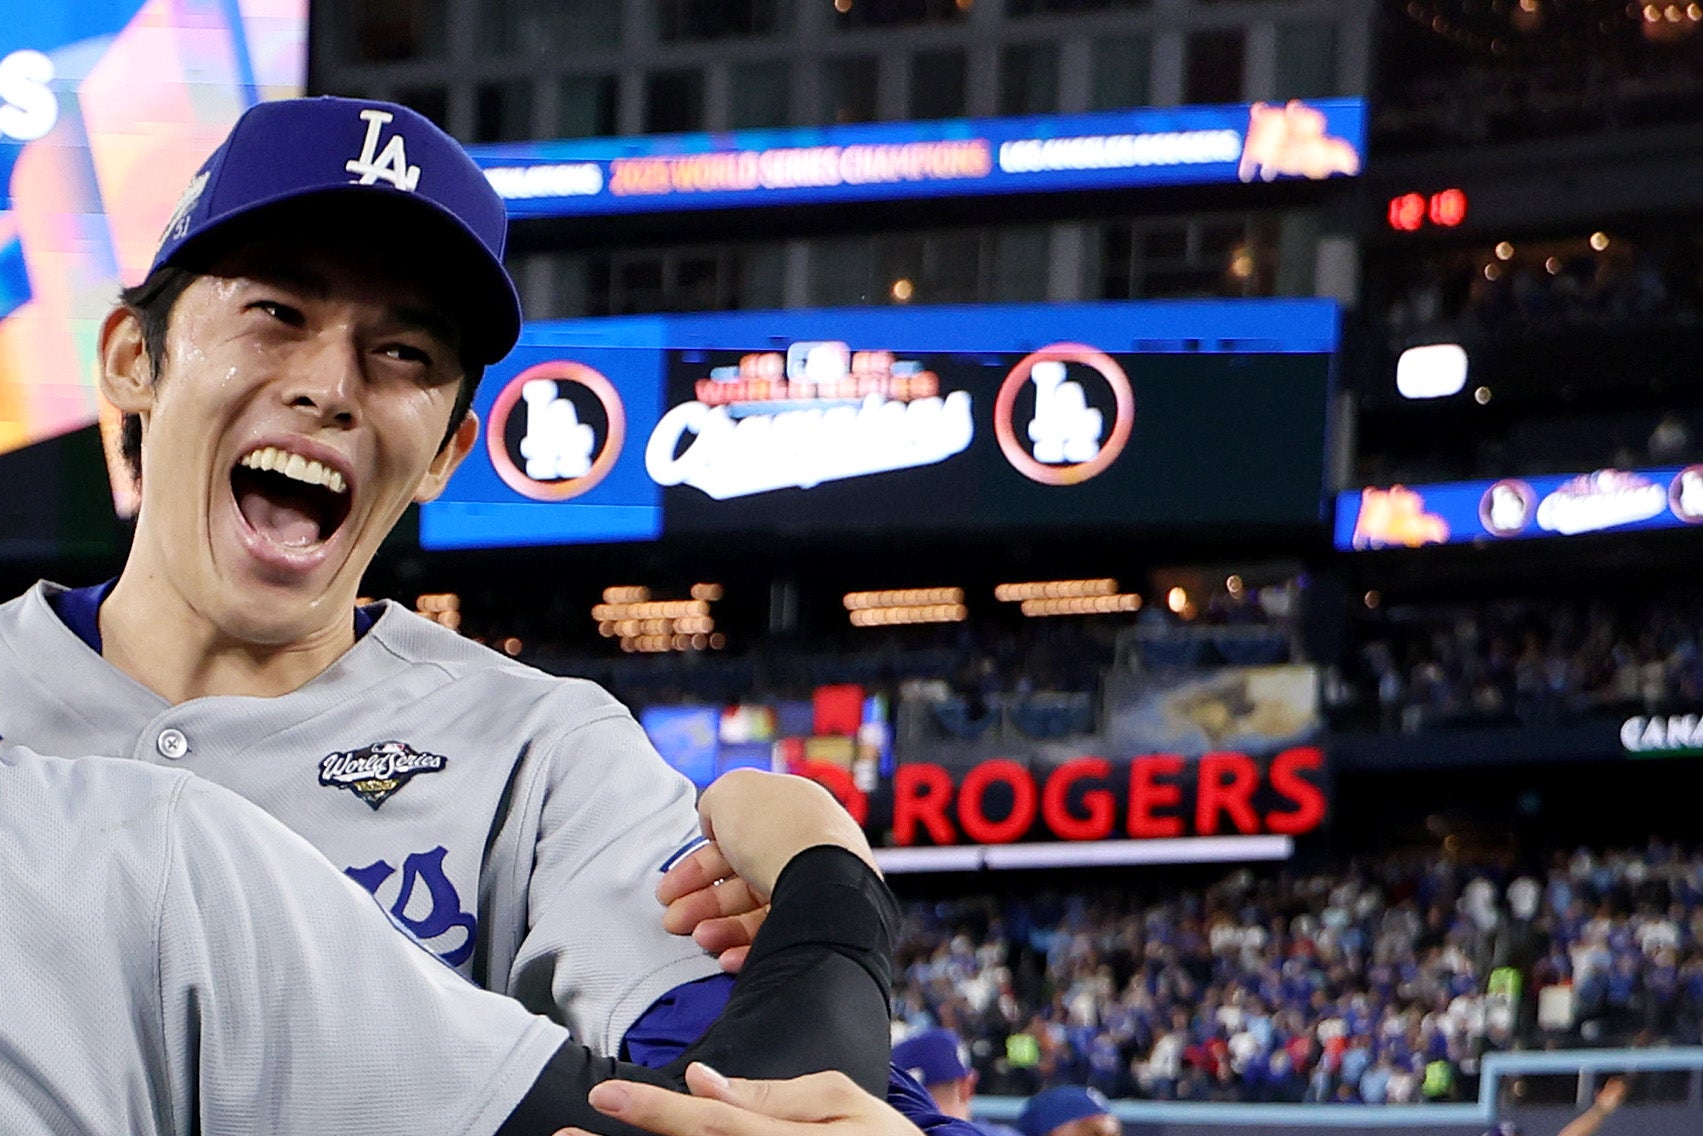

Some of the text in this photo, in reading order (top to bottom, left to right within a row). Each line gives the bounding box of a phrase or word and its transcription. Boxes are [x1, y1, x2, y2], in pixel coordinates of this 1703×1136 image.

[346, 109, 422, 192] LA
[322, 751, 442, 781] World Series
[893, 746, 1327, 845] ROGERS
